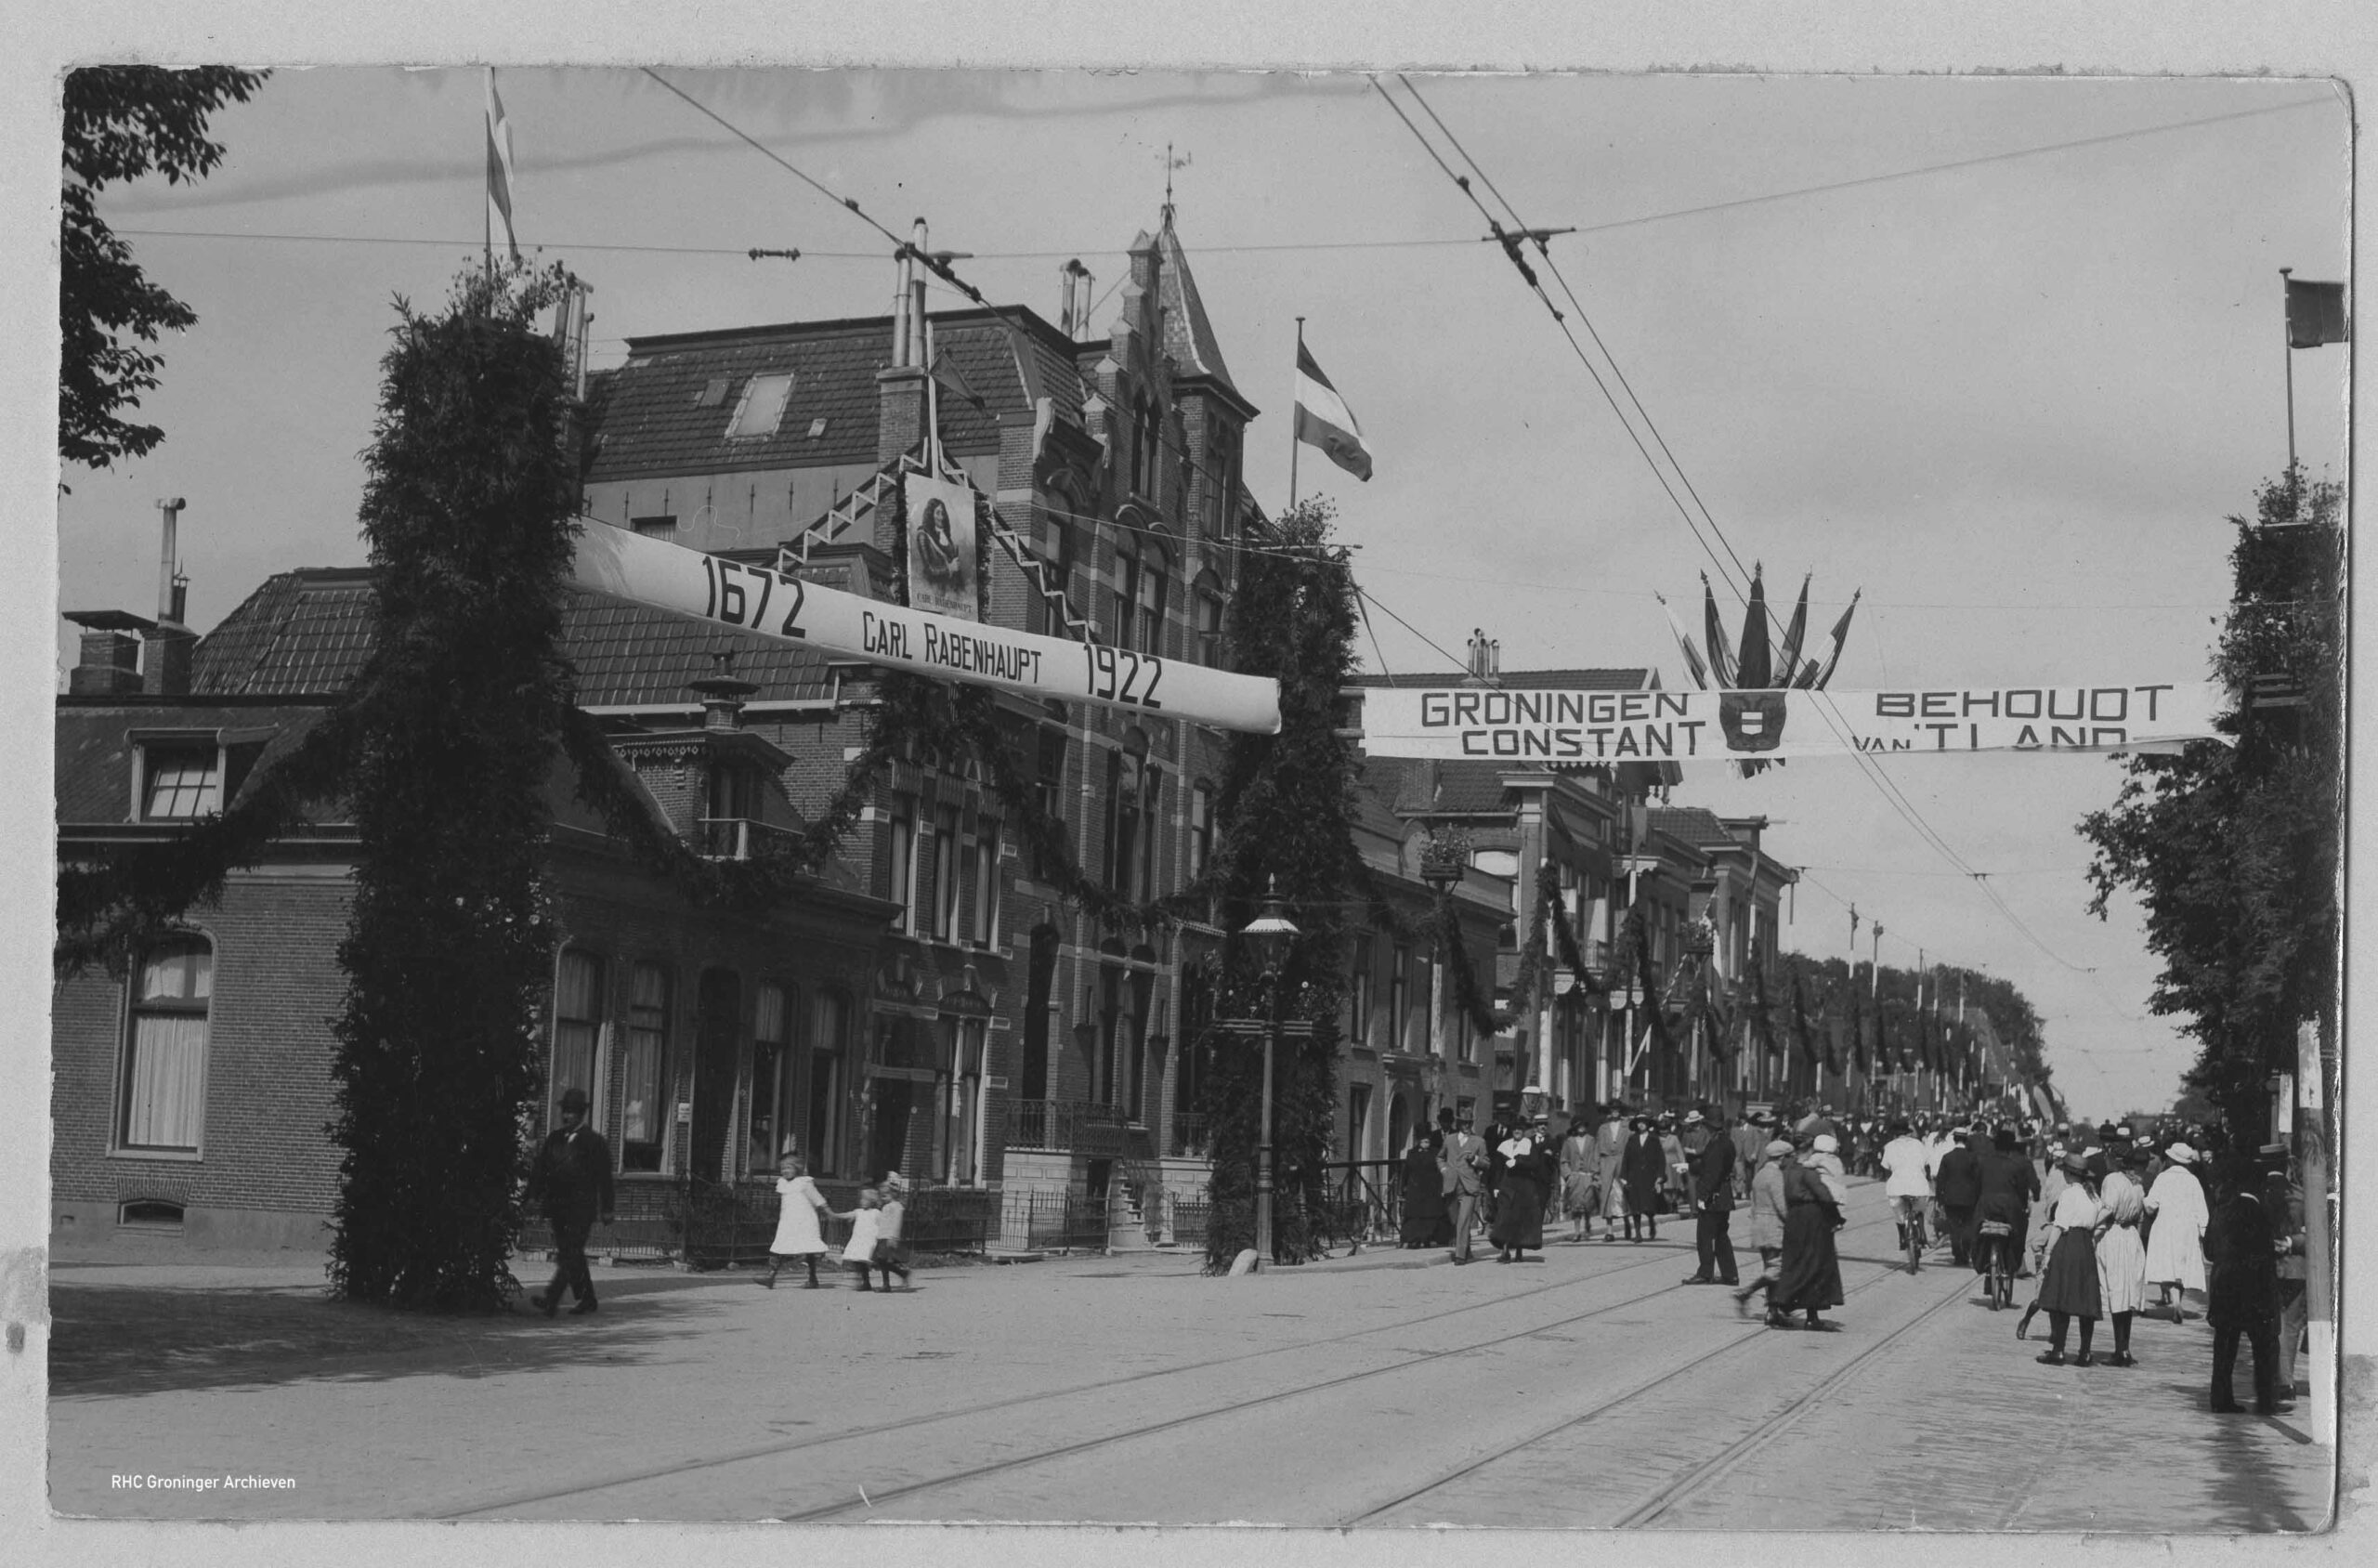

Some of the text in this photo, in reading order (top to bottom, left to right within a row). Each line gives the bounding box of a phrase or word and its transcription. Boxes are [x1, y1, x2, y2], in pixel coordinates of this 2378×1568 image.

[700, 555, 1163, 709] 1672 CARL RABENHAUPT 1922
[1421, 692, 1689, 727] GRONINGEN
[1876, 685, 2174, 721] BEHOUDT
[1461, 721, 1706, 757] CONSTANT
[1852, 736, 1911, 751] VAN
